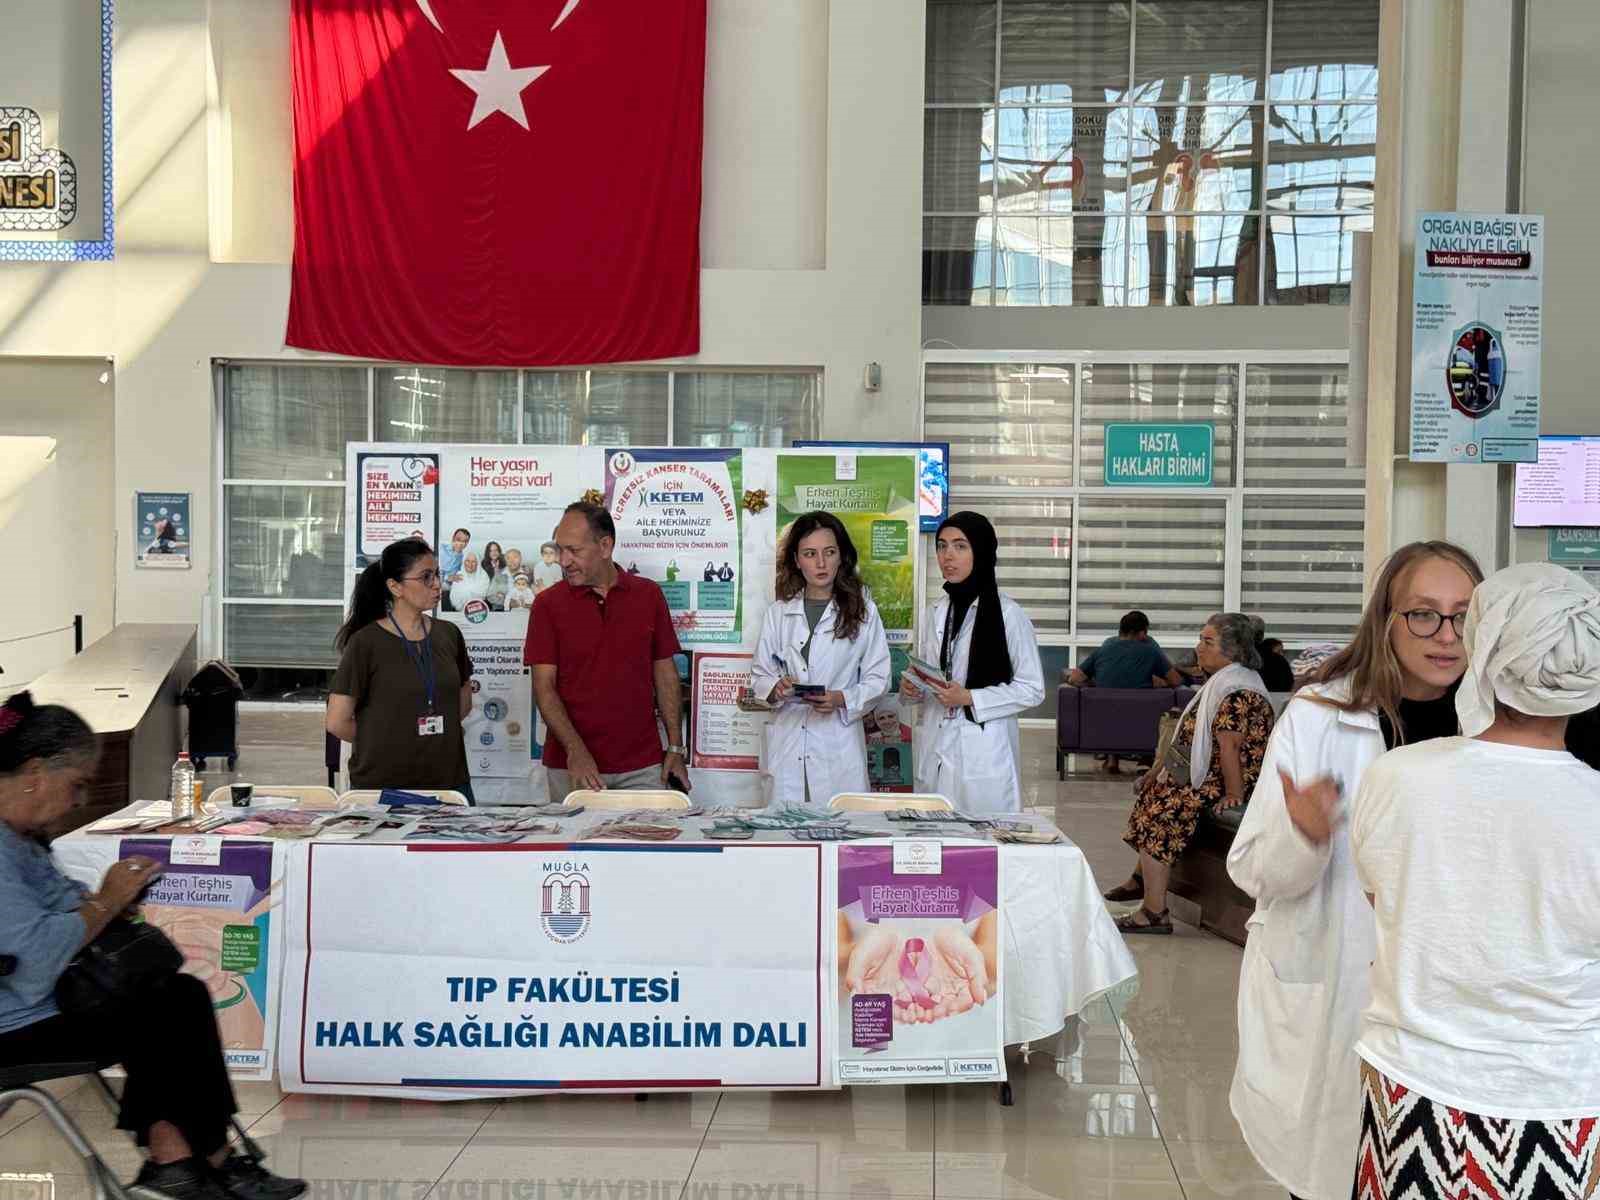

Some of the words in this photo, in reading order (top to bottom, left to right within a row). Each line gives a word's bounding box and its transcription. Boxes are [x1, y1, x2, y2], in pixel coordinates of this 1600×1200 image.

[1422, 219, 1472, 235] ORGAN
[1474, 218, 1516, 238] BAĞIŞI
[1519, 222, 1538, 237] VE
[1139, 432, 1179, 452] HASTA
[471, 456, 497, 471] Her
[1112, 456, 1164, 476] HAKLARI
[1167, 451, 1206, 477] BİRİMİ
[470, 471, 490, 487] bir
[526, 472, 553, 487] var!
[645, 464, 687, 480] KANSER
[367, 481, 380, 489] EN
[383, 481, 413, 489] YAKIN
[650, 492, 704, 503] KETEM
[662, 508, 687, 516] VEYA
[192, 875, 233, 892] Teşhis
[150, 889, 184, 903] Hayat
[872, 887, 911, 899] Erken
[872, 902, 909, 915] Hayat
[447, 977, 497, 1003] TIP
[507, 970, 679, 1003] FAKÜLTESİ
[315, 1021, 403, 1048] HALK
[413, 1014, 549, 1048] SAĞLIĞI
[559, 1015, 721, 1048] ANABİLİM
[733, 1021, 807, 1048] DALI
[960, 1063, 993, 1073] KETEM
